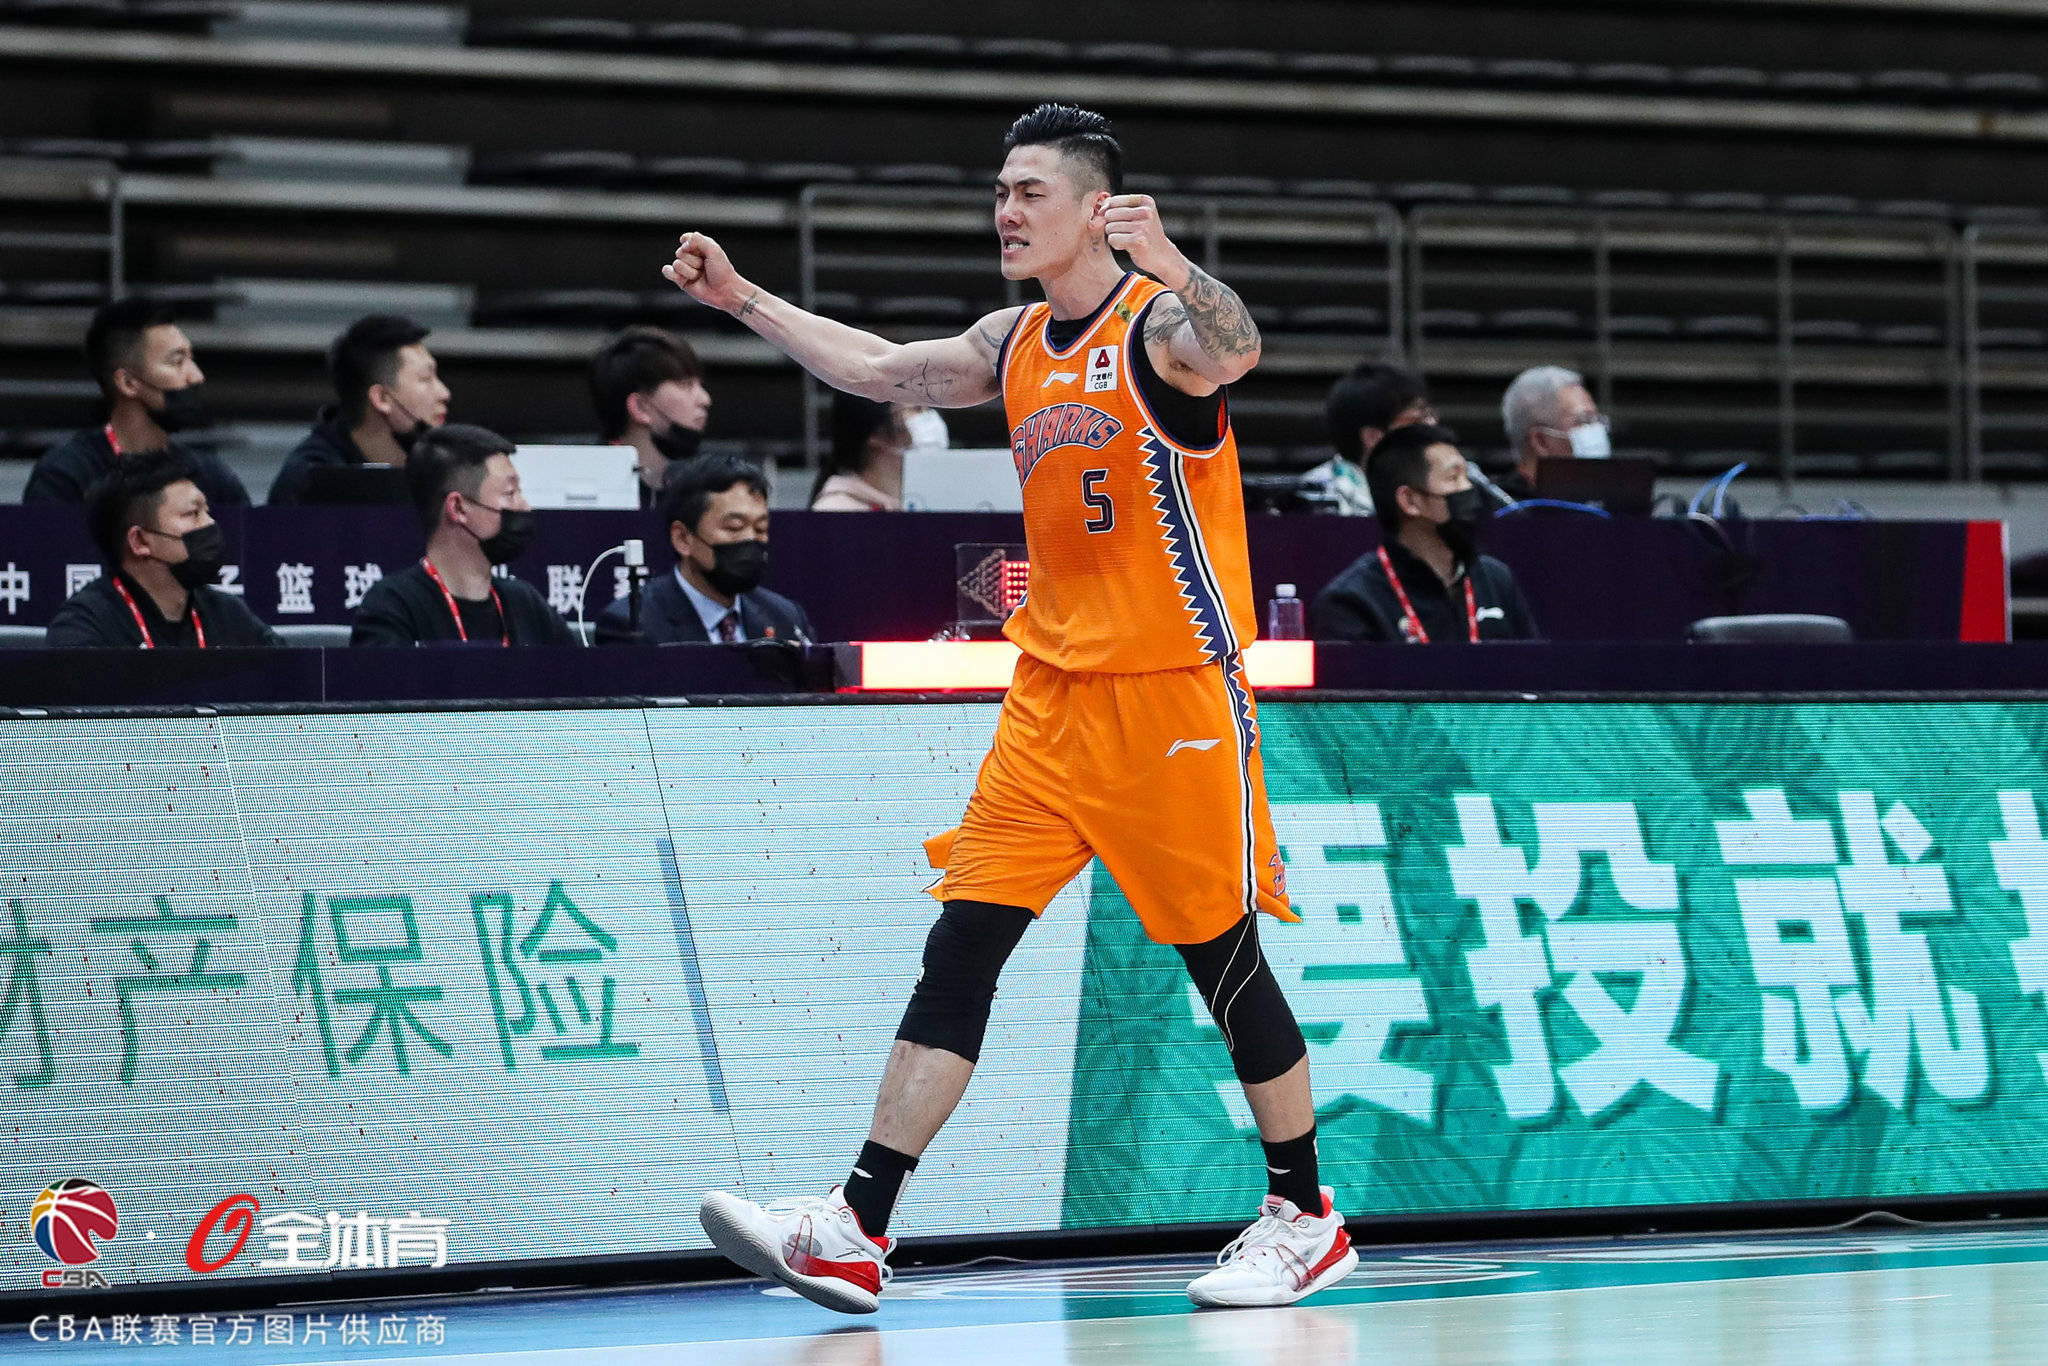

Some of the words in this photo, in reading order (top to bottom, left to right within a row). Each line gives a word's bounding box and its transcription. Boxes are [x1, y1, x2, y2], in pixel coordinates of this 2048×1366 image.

[1094, 381, 1108, 389] CGB
[1010, 401, 1124, 490] SHARKS
[1081, 468, 1116, 534] 5
